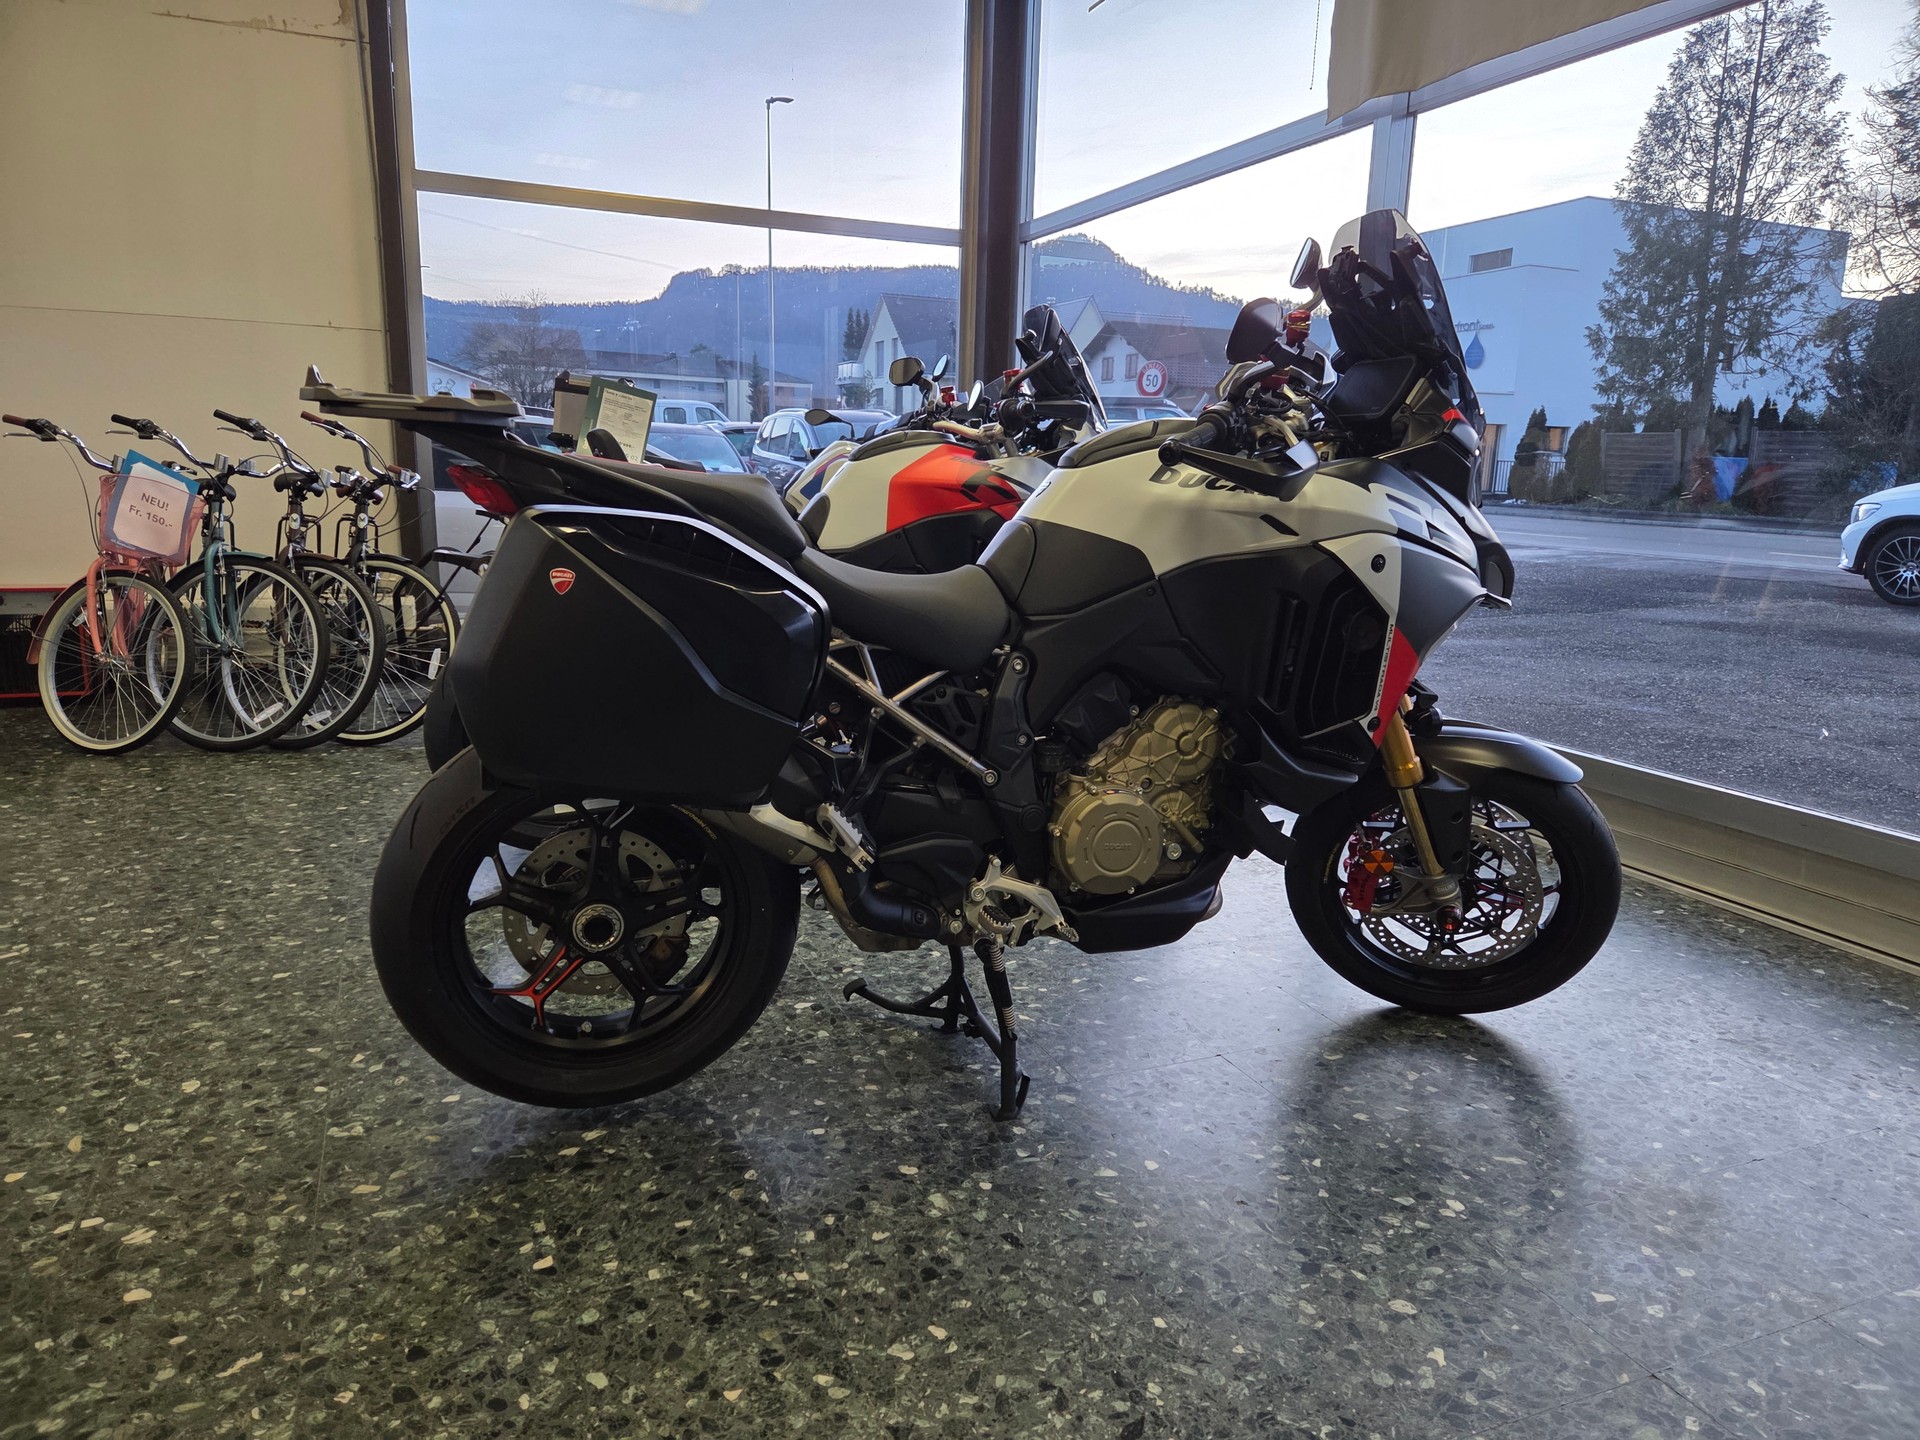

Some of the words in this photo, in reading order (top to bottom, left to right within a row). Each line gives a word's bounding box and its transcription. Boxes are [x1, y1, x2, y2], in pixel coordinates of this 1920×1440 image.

[1145, 374, 1159, 388] 50
[140, 492, 170, 511] NEU!
[128, 504, 142, 517] Fr.
[146, 512, 173, 528] 150.-
